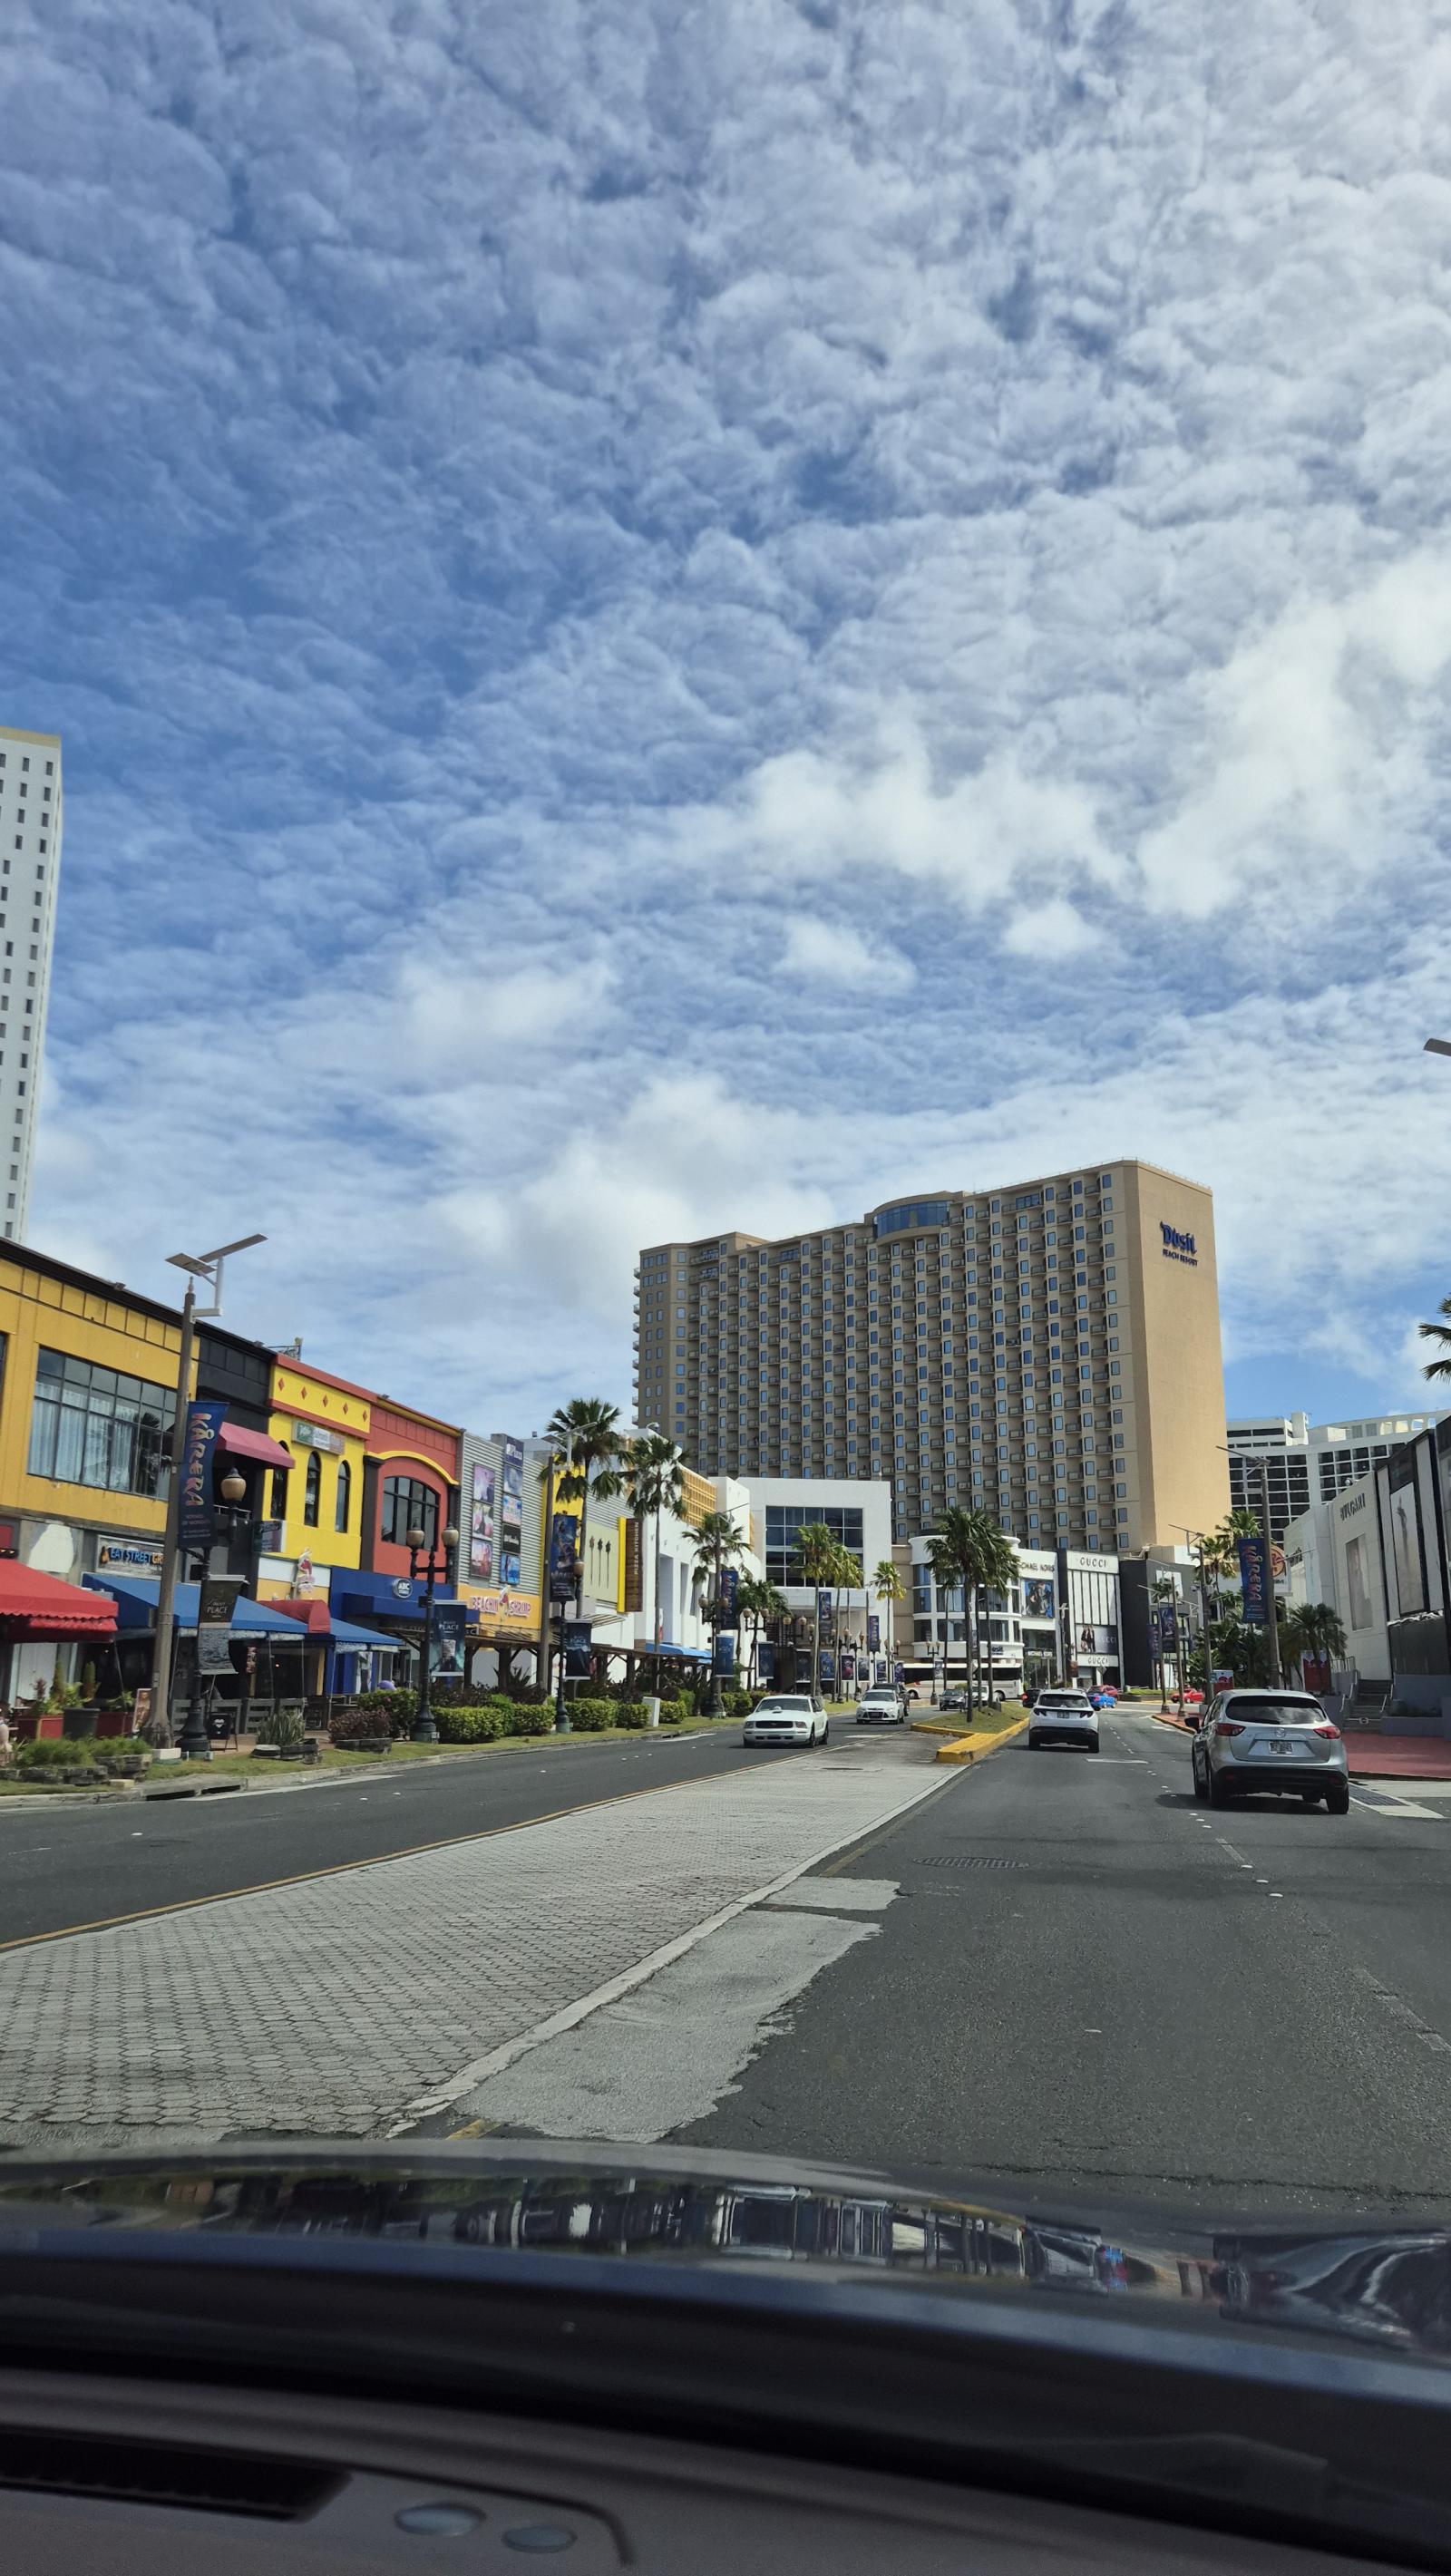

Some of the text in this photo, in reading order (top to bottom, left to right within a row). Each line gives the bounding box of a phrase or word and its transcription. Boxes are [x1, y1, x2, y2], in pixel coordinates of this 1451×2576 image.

[1163, 1249, 1198, 1267] BEACH RESORT
[1340, 1492, 1365, 1521] BVLGARI
[110, 1548, 124, 1560] EAT
[125, 1550, 151, 1563] STREET
[1080, 1557, 1105, 1568] GUCCI
[207, 1606, 229, 1614] PLACE
